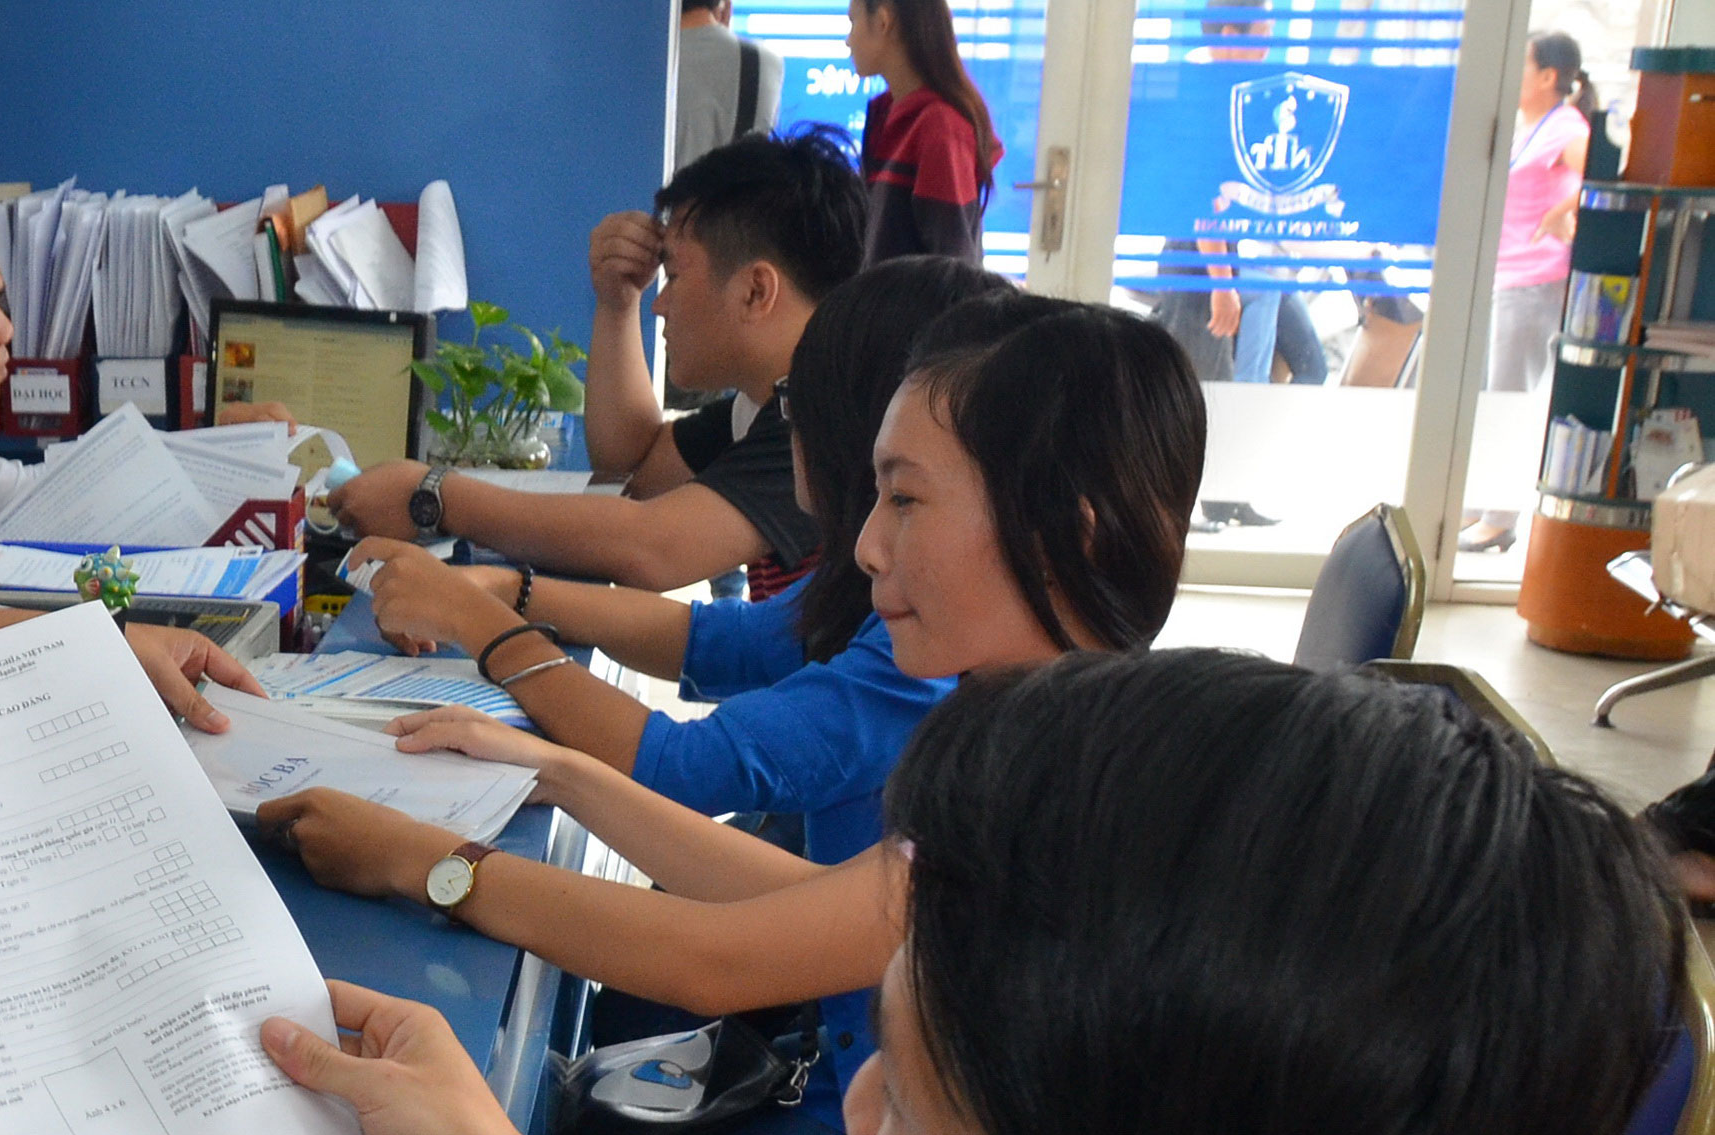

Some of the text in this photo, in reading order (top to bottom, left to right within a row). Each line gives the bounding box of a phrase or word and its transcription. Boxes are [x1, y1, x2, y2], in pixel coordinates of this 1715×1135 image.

[111, 376, 151, 388] TCCN
[20, 645, 44, 659] VIỆT
[43, 638, 66, 652] NAM
[19, 691, 52, 710] ĐẲNG
